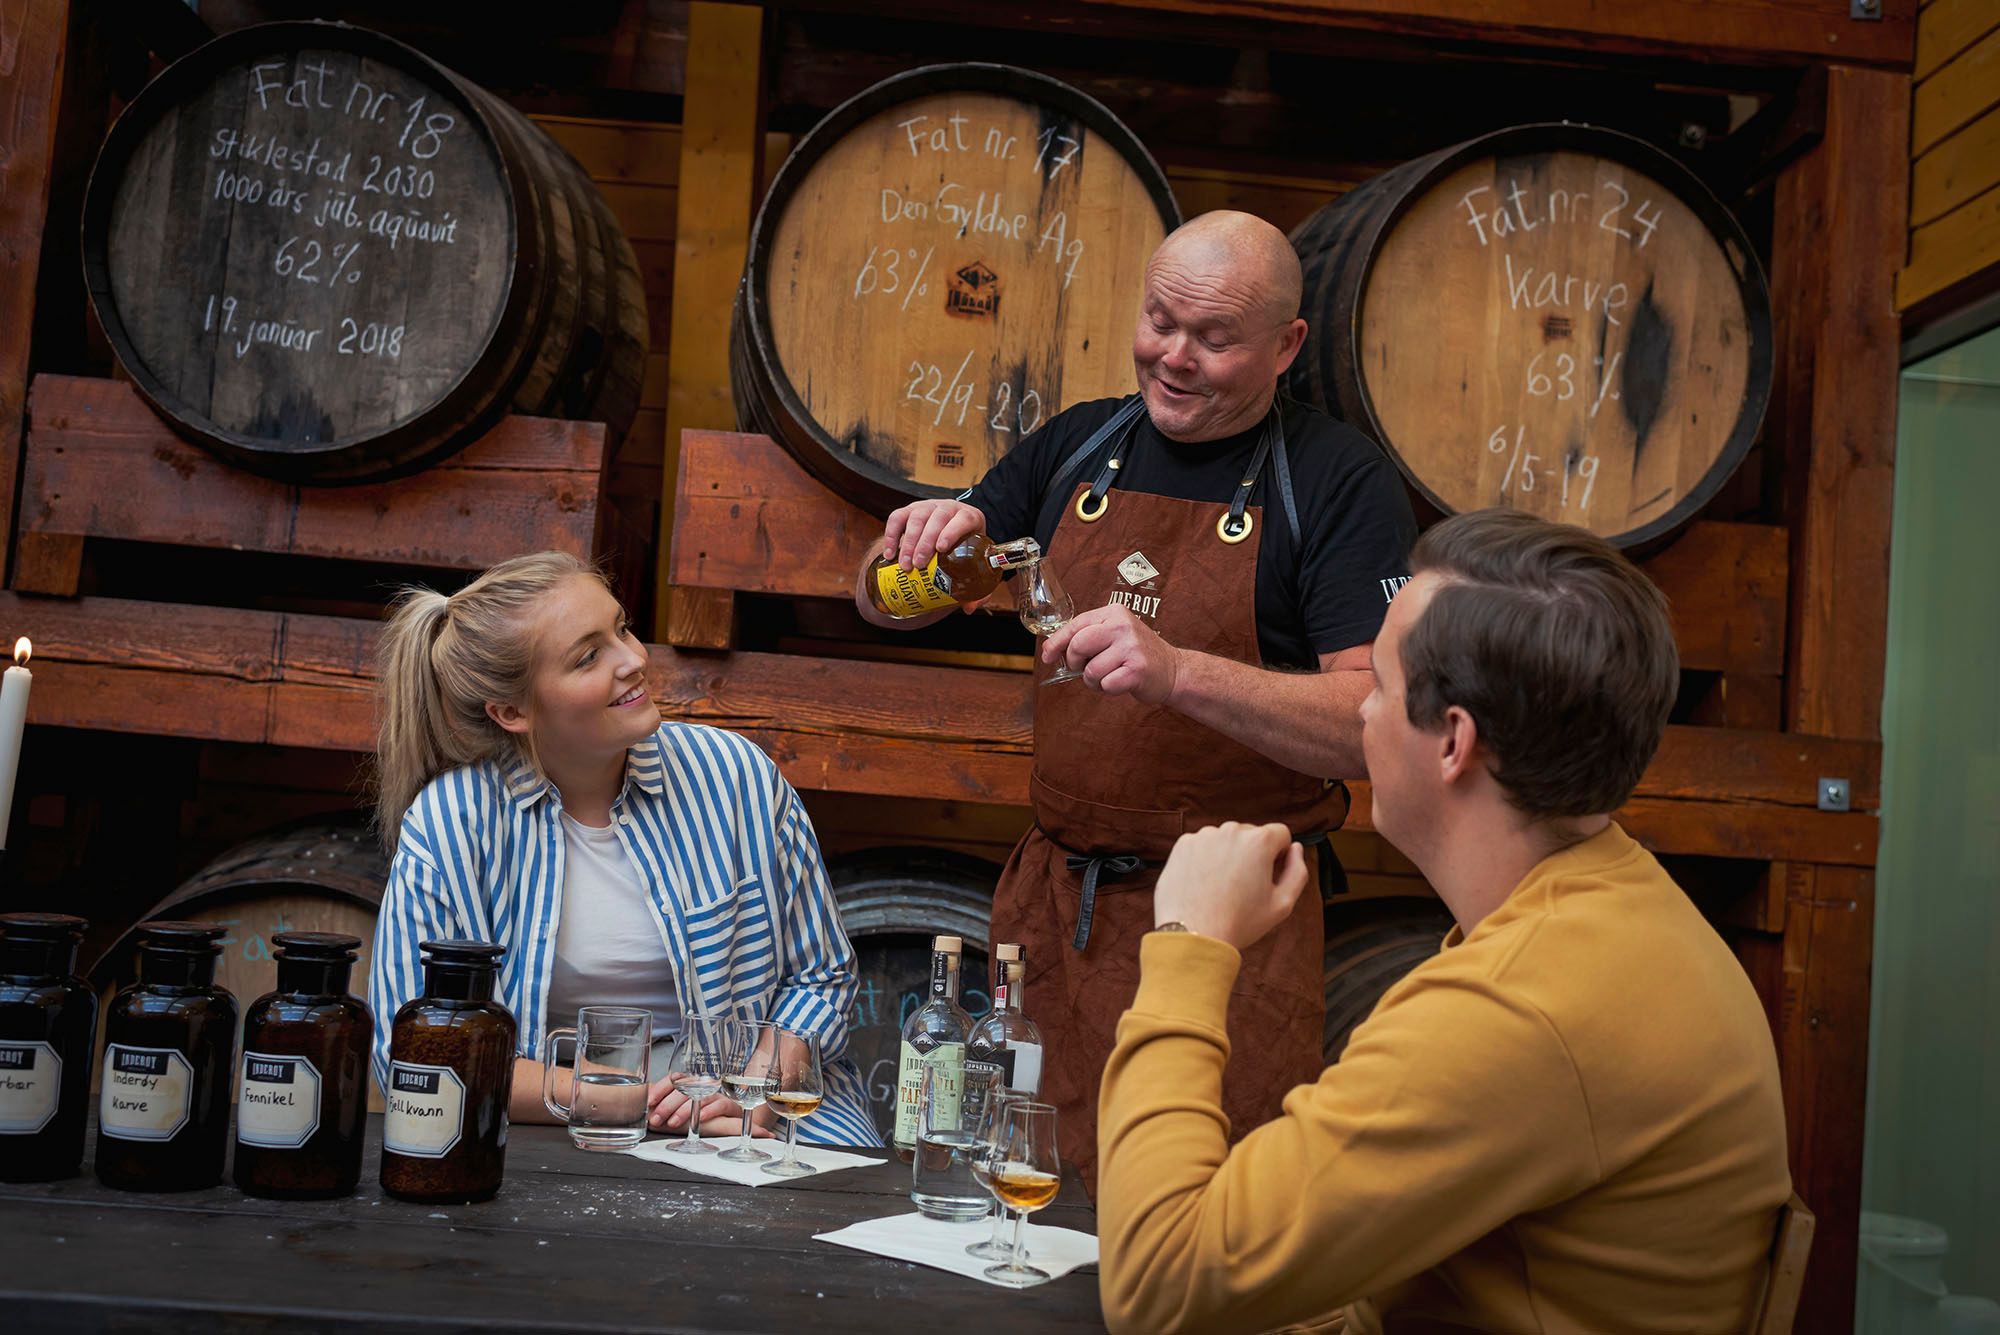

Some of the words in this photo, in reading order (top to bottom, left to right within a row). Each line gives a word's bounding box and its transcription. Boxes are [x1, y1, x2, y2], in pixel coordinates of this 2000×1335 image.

[251, 61, 335, 111] Fat
[345, 82, 395, 123] nr.
[398, 96, 455, 159] 18
[210, 128, 352, 183] Stiklestad
[362, 155, 435, 199] 2030
[898, 110, 970, 157] Fat
[985, 126, 1017, 160] nr.
[1033, 126, 1082, 180] 17
[214, 169, 264, 204] 1000
[268, 178, 309, 213] års
[1600, 181, 1662, 248] 24
[881, 188, 928, 223] Den
[934, 183, 1028, 240] Gyldne
[1038, 211, 1084, 290] Aq
[854, 246, 935, 312] 63%
[204, 294, 238, 333] 19.
[338, 317, 406, 357] 2018
[904, 350, 1042, 435] 22/9-20
[895, 568, 924, 610] AQUAVIT
[245, 1087, 295, 1106] Fennikel
